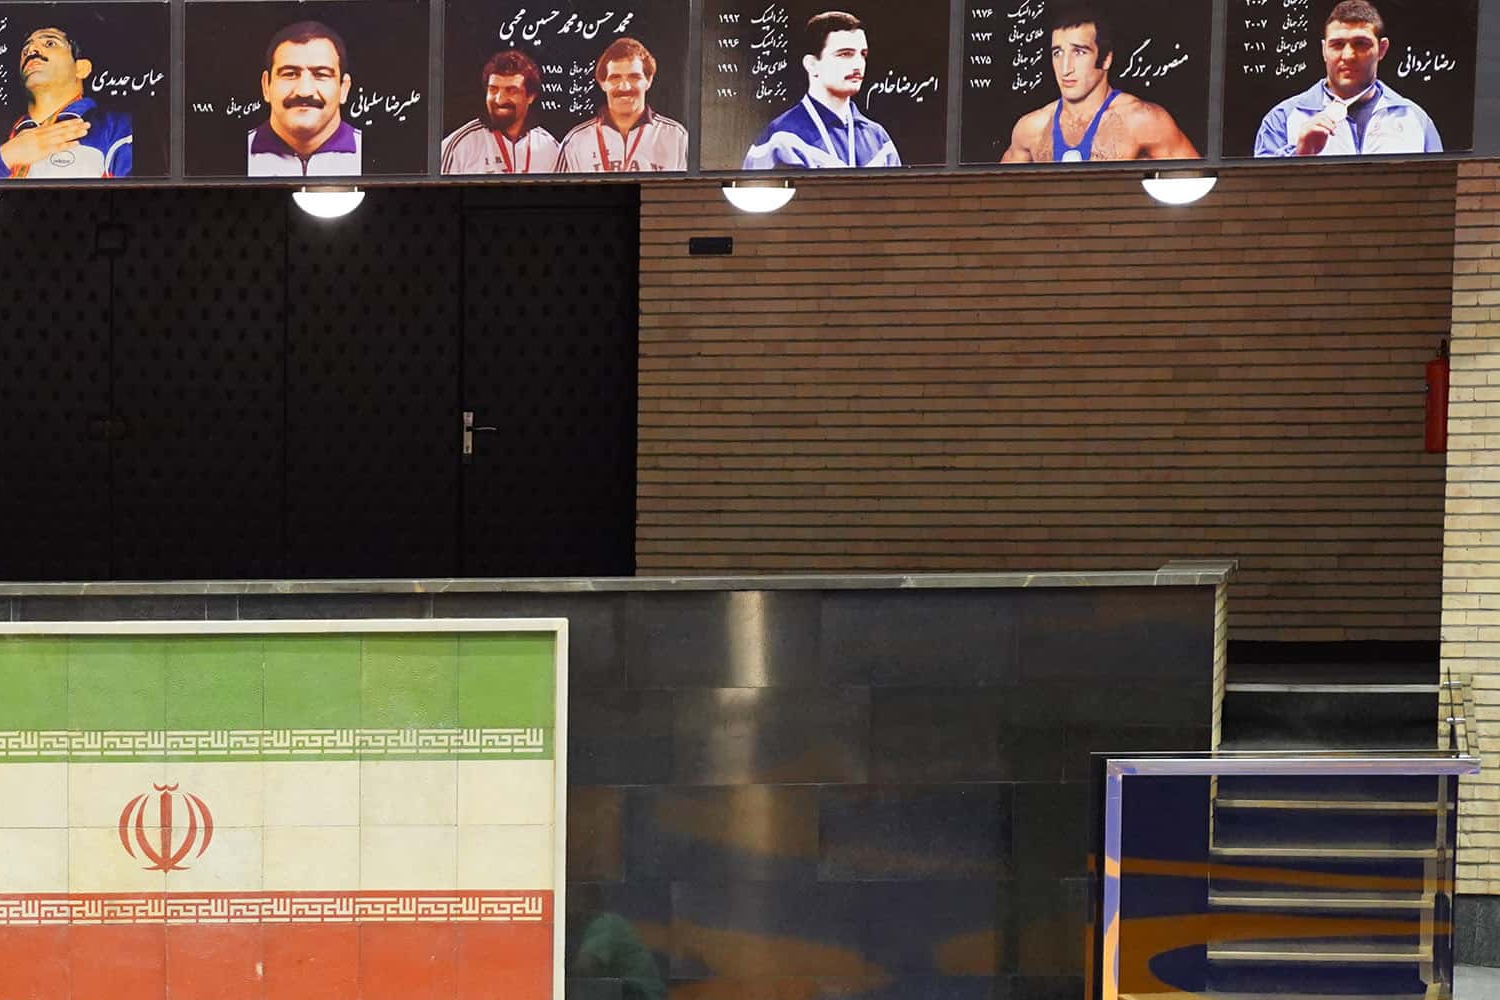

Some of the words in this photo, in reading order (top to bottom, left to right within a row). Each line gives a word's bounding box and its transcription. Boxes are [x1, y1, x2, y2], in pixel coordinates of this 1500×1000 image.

[499, 8, 526, 47] محبی
[522, 10, 560, 46] حسین
[557, 13, 578, 34] محمد
[582, 11, 614, 39] حسن
[612, 12, 634, 33] محمد
[718, 38, 739, 48] ۱۹۹۶
[541, 64, 563, 74] ۱۹۸۵
[718, 63, 738, 72] ۱۹۹۱
[970, 55, 992, 65] ۱۹۷۵
[1152, 43, 1189, 77] منصور
[1397, 46, 1432, 82] یزدانی
[1434, 53, 1456, 71] رضا
[91, 70, 131, 96] جدیدی
[131, 69, 165, 97] عباس
[541, 83, 563, 92] ۱۹۷۸
[717, 88, 737, 97] ۱۹۹۰
[865, 70, 896, 110] خادم
[970, 78, 992, 88] ۱۹۷۷
[192, 103, 214, 113] ۱۹۸۹
[350, 87, 384, 126] سلیمانی
[385, 89, 421, 121] علیرضا
[541, 100, 561, 110] ۱۹۹۰
